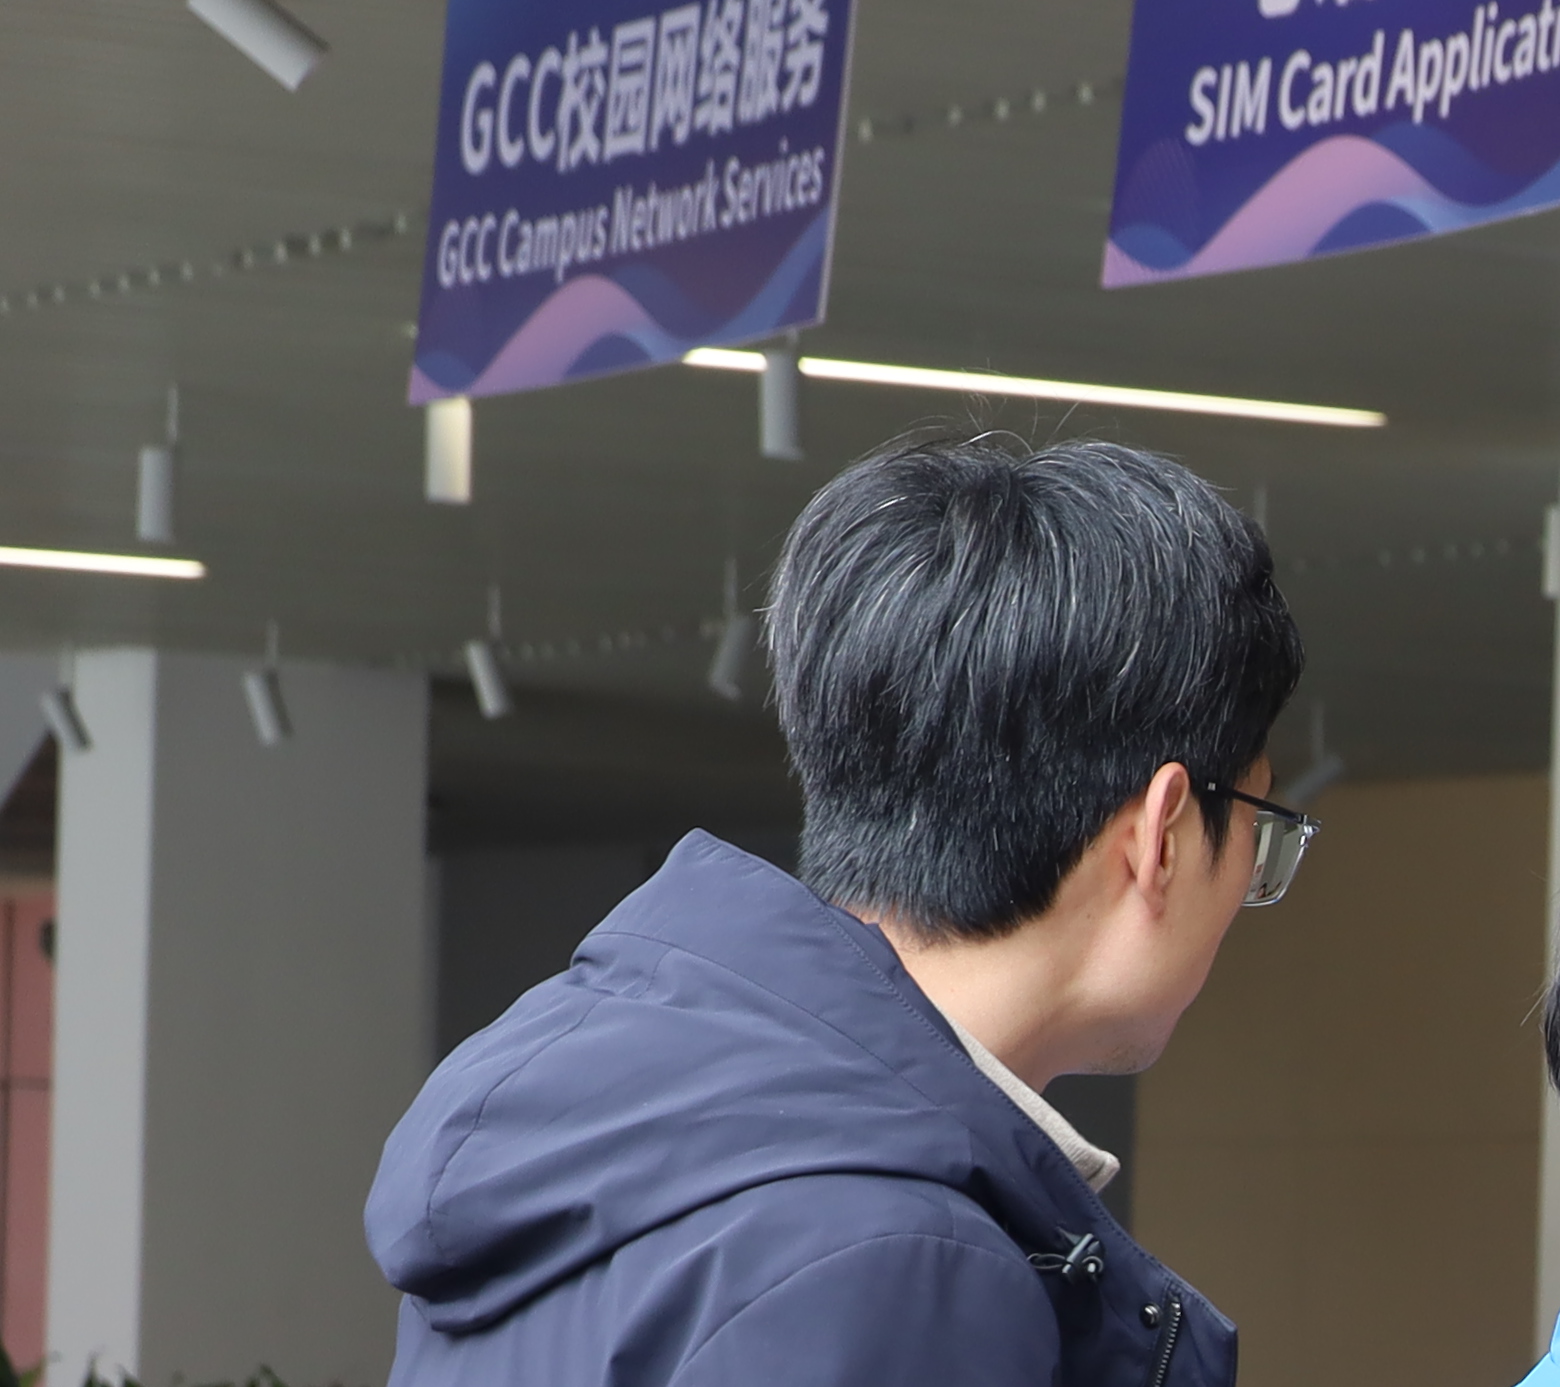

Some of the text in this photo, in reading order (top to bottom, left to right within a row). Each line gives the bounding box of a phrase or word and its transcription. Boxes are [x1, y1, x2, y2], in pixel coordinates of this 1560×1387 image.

[1184, 57, 1273, 146] SIM
[1278, 30, 1385, 131] Card
[437, 137, 826, 290] GCC Campus Network Services
